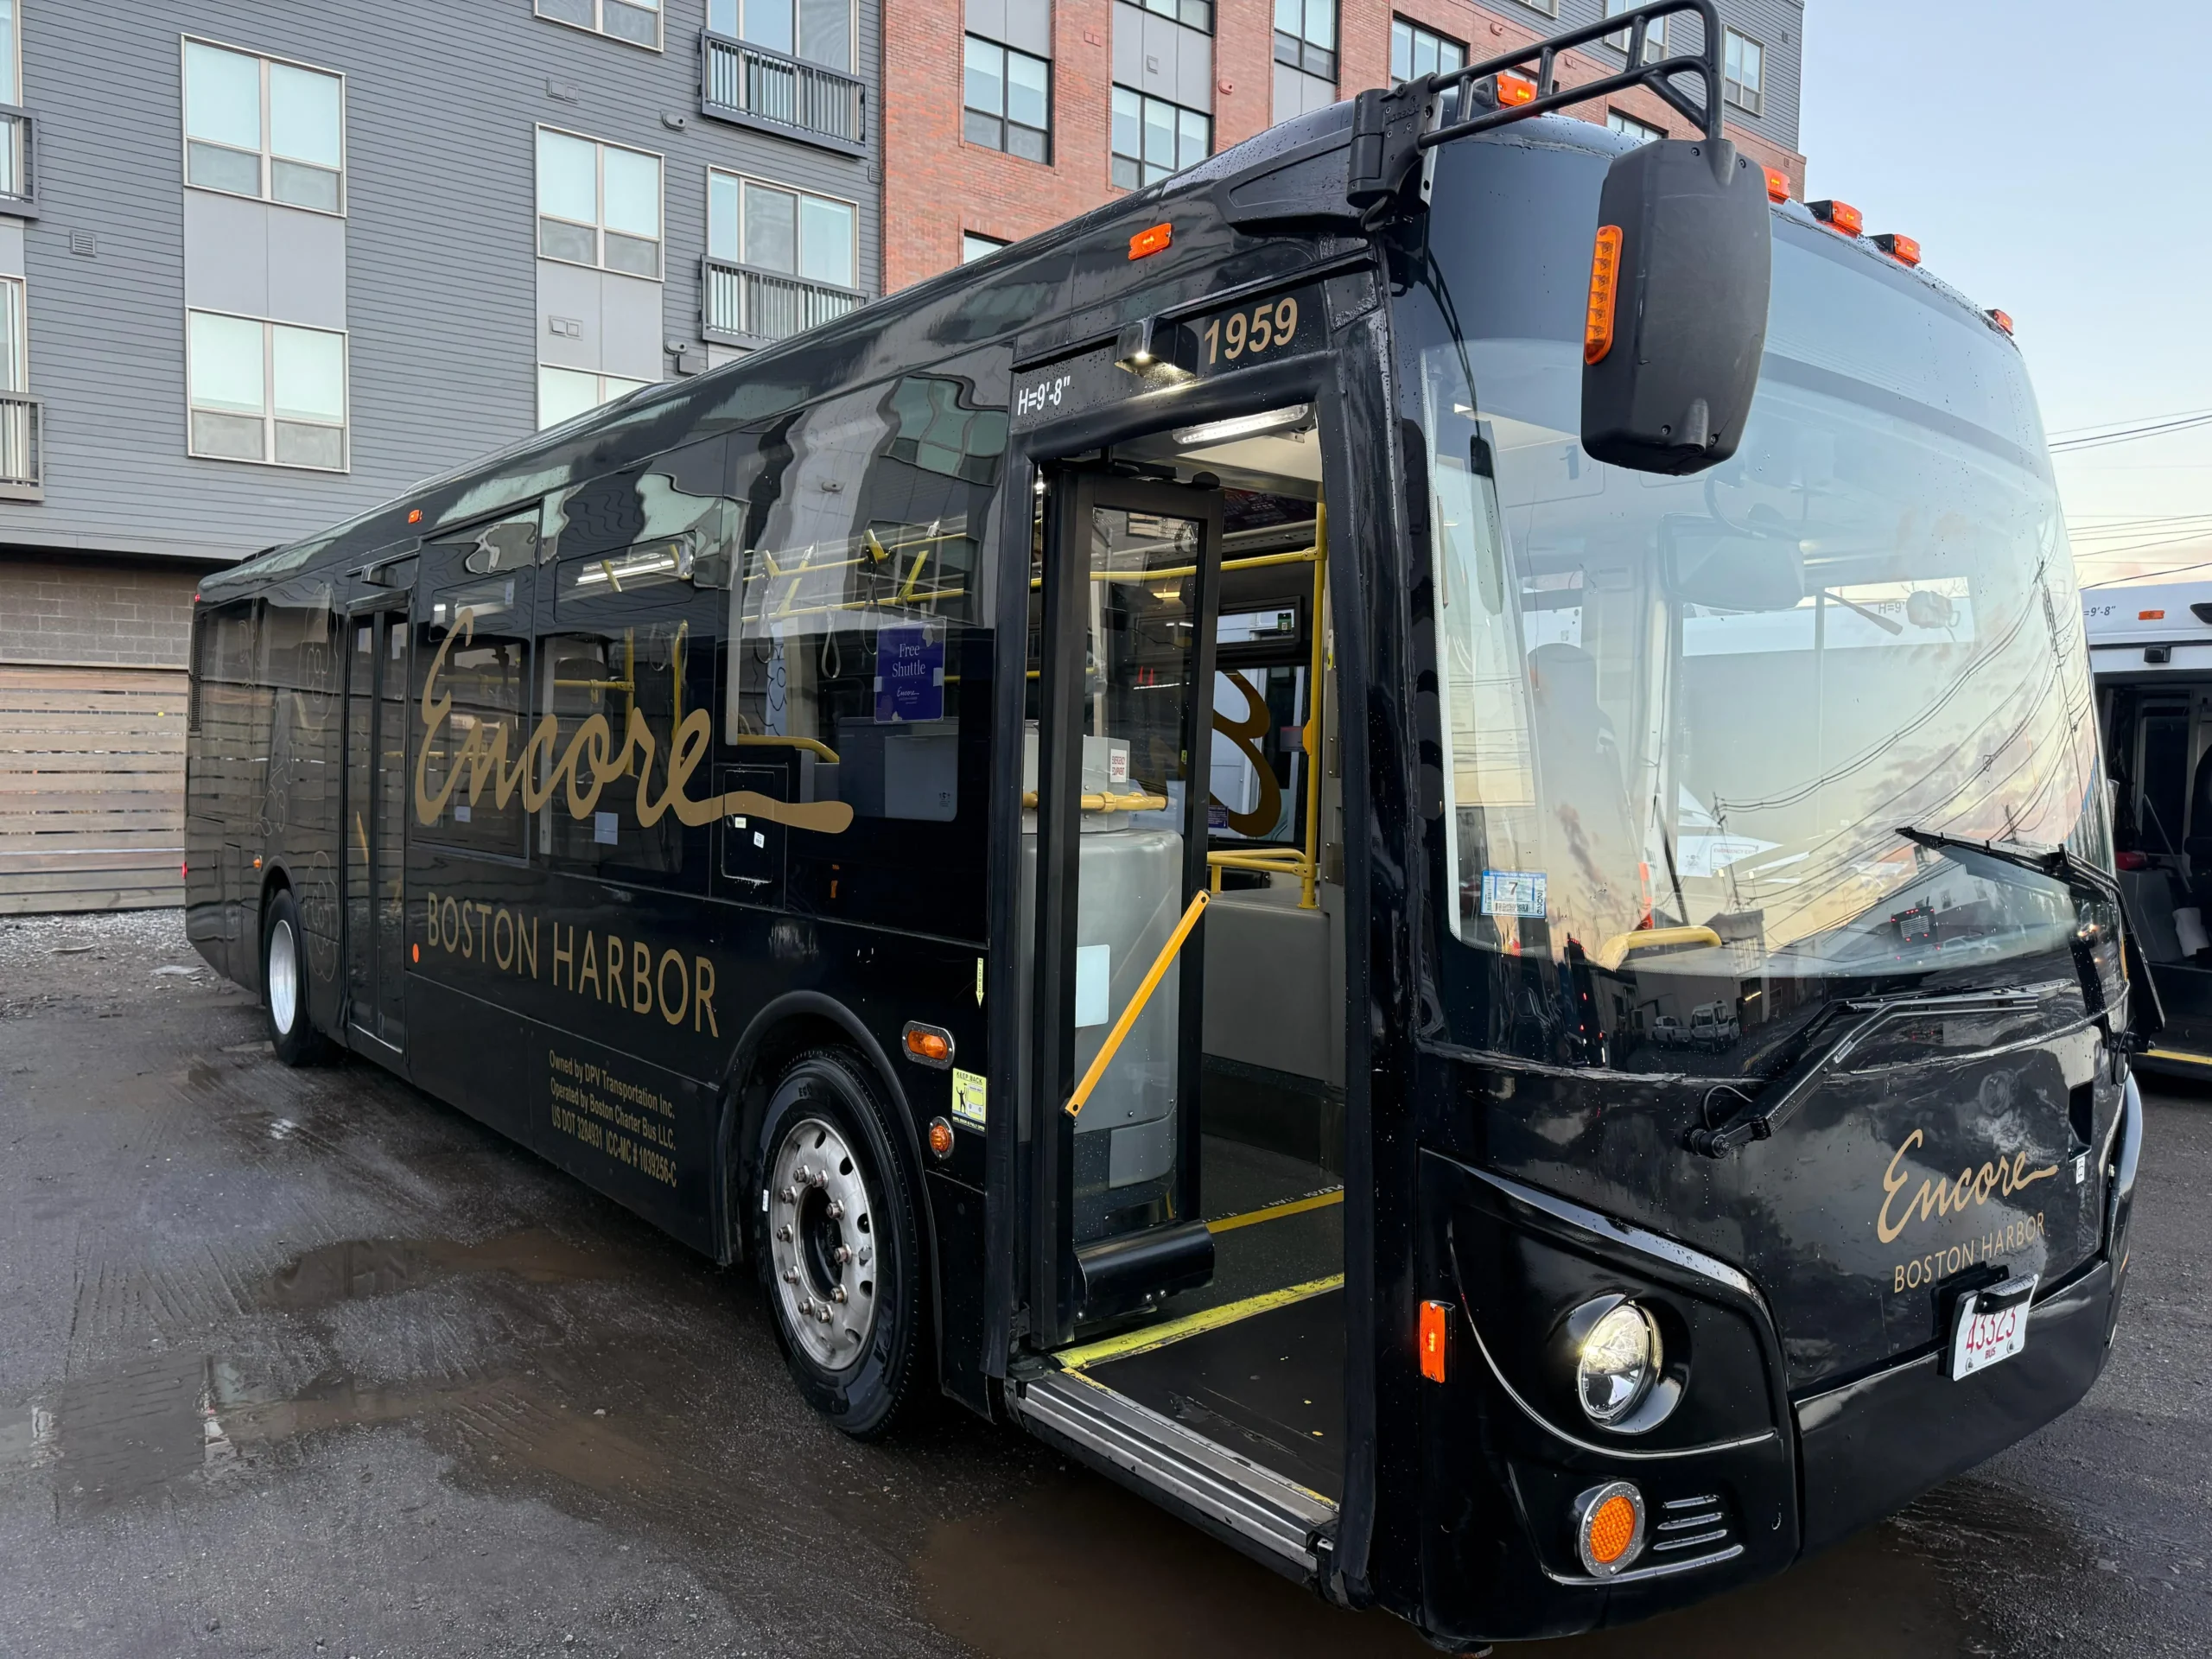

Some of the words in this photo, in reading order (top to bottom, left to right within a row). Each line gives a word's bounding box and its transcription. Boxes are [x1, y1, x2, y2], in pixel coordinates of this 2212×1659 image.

[1204, 296, 1299, 365] 1959
[1017, 375, 1071, 416] H=9'-8"
[1878, 601, 1905, 614] H=9'
[2083, 606, 2116, 617] =9'-8"
[892, 660, 926, 677] Shuttle
[899, 643, 920, 658] Free
[897, 686, 919, 697] Encore
[415, 607, 854, 834] Encore
[1509, 881, 1518, 895] 7
[428, 892, 537, 980] BOSTON
[553, 922, 719, 1038] HARBOR
[550, 1049, 573, 1075] Owned
[575, 1059, 584, 1084] by
[585, 1063, 601, 1086] DPV
[602, 1070, 658, 1111] Transportation
[659, 1093, 676, 1119] Inc.
[956, 1071, 969, 1080] KEEP
[969, 1075, 982, 1084] BACK
[550, 1077, 579, 1104] Operated
[580, 1089, 588, 1114] by
[590, 1094, 613, 1121] Boston
[614, 1104, 640, 1134] Charter
[642, 1117, 657, 1141] Bus
[658, 1123, 677, 1151] LLC.
[551, 1104, 562, 1129] US
[563, 1109, 576, 1136] DOT
[606, 1129, 631, 1165] ICC-MC
[1877, 1128, 2058, 1244] Encore
[1894, 1239, 1976, 1294] BOSTON
[1981, 1211, 2045, 1262] HARBOR
[1985, 1347, 1996, 1359] BUS
